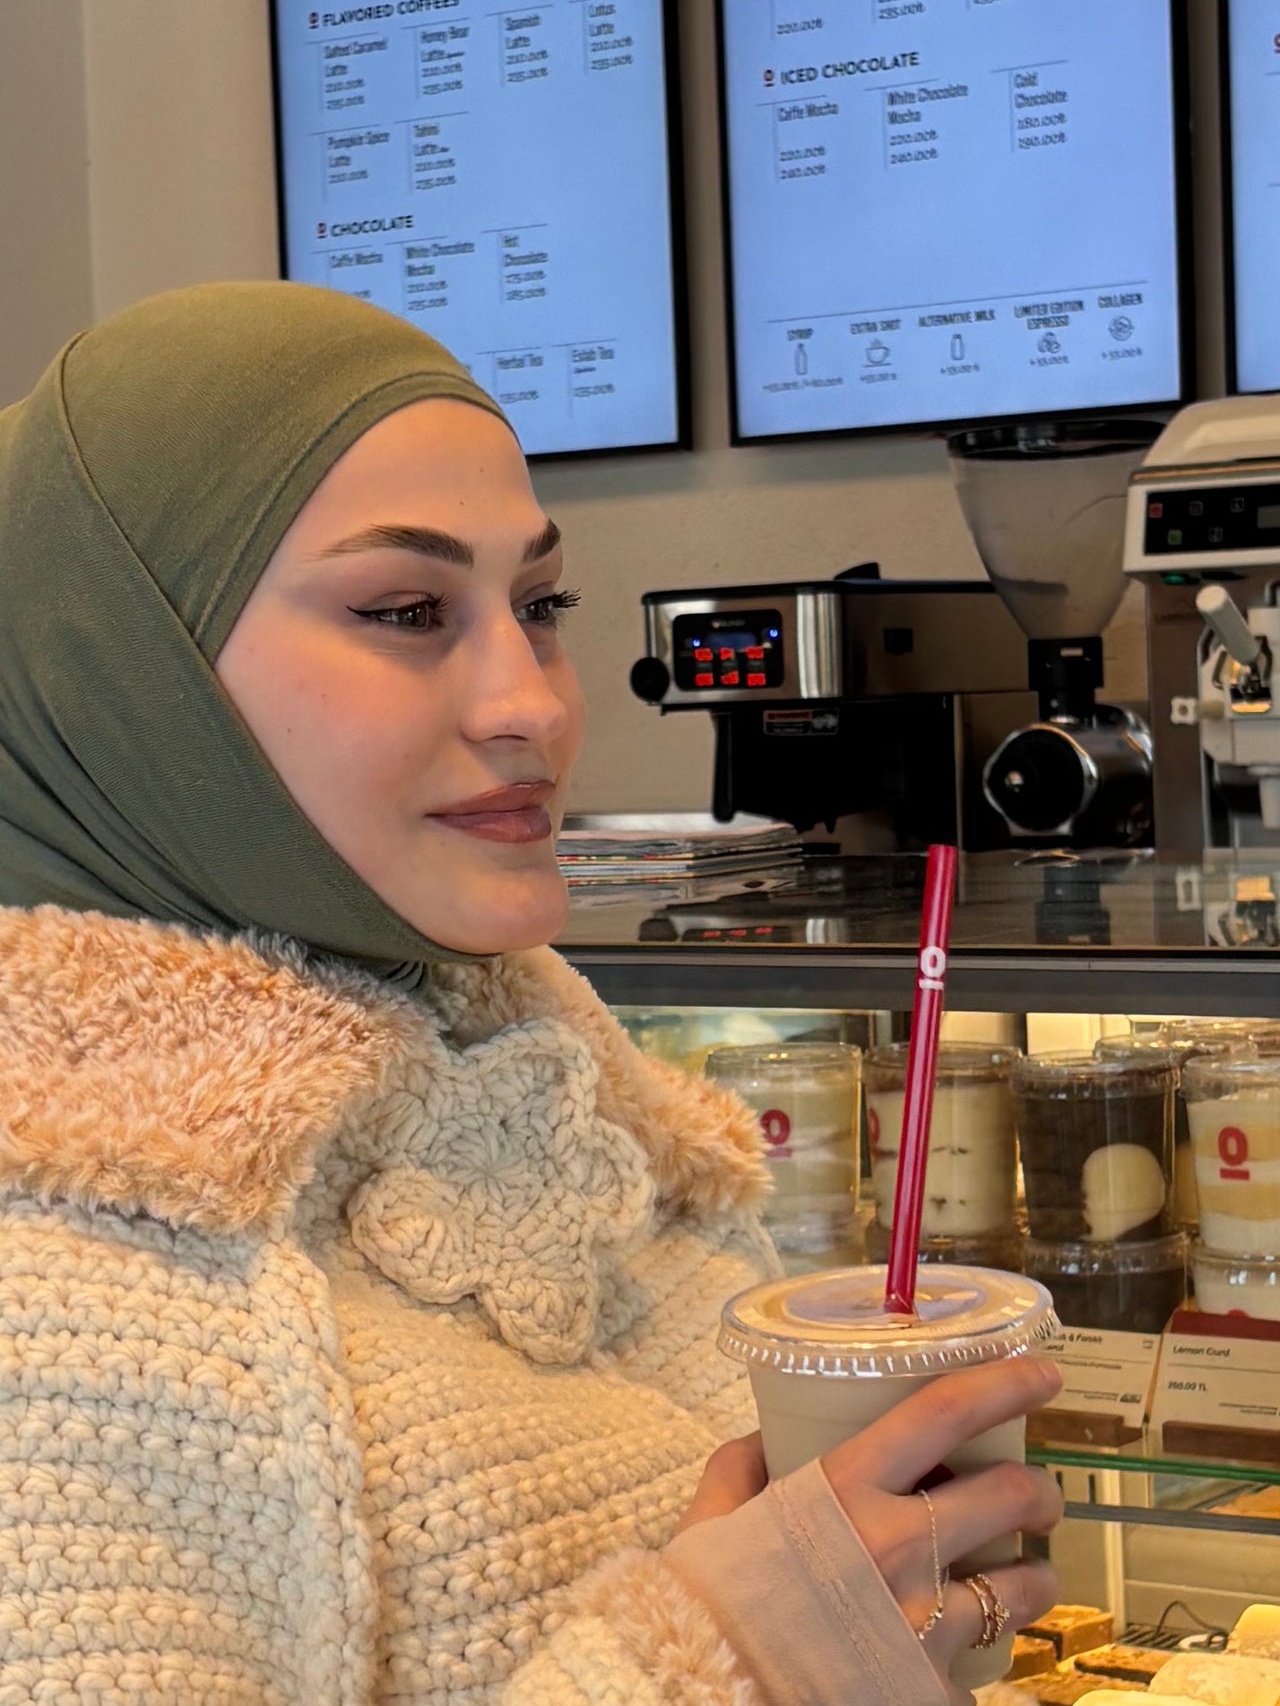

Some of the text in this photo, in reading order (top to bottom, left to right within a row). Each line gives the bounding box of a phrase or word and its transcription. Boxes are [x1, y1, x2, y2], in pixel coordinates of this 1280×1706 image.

[781, 51, 920, 86] ICED CHOCOLATE
[331, 215, 414, 237] CHOCOLATE
[1173, 1345, 1230, 1358] Lemon Curd
